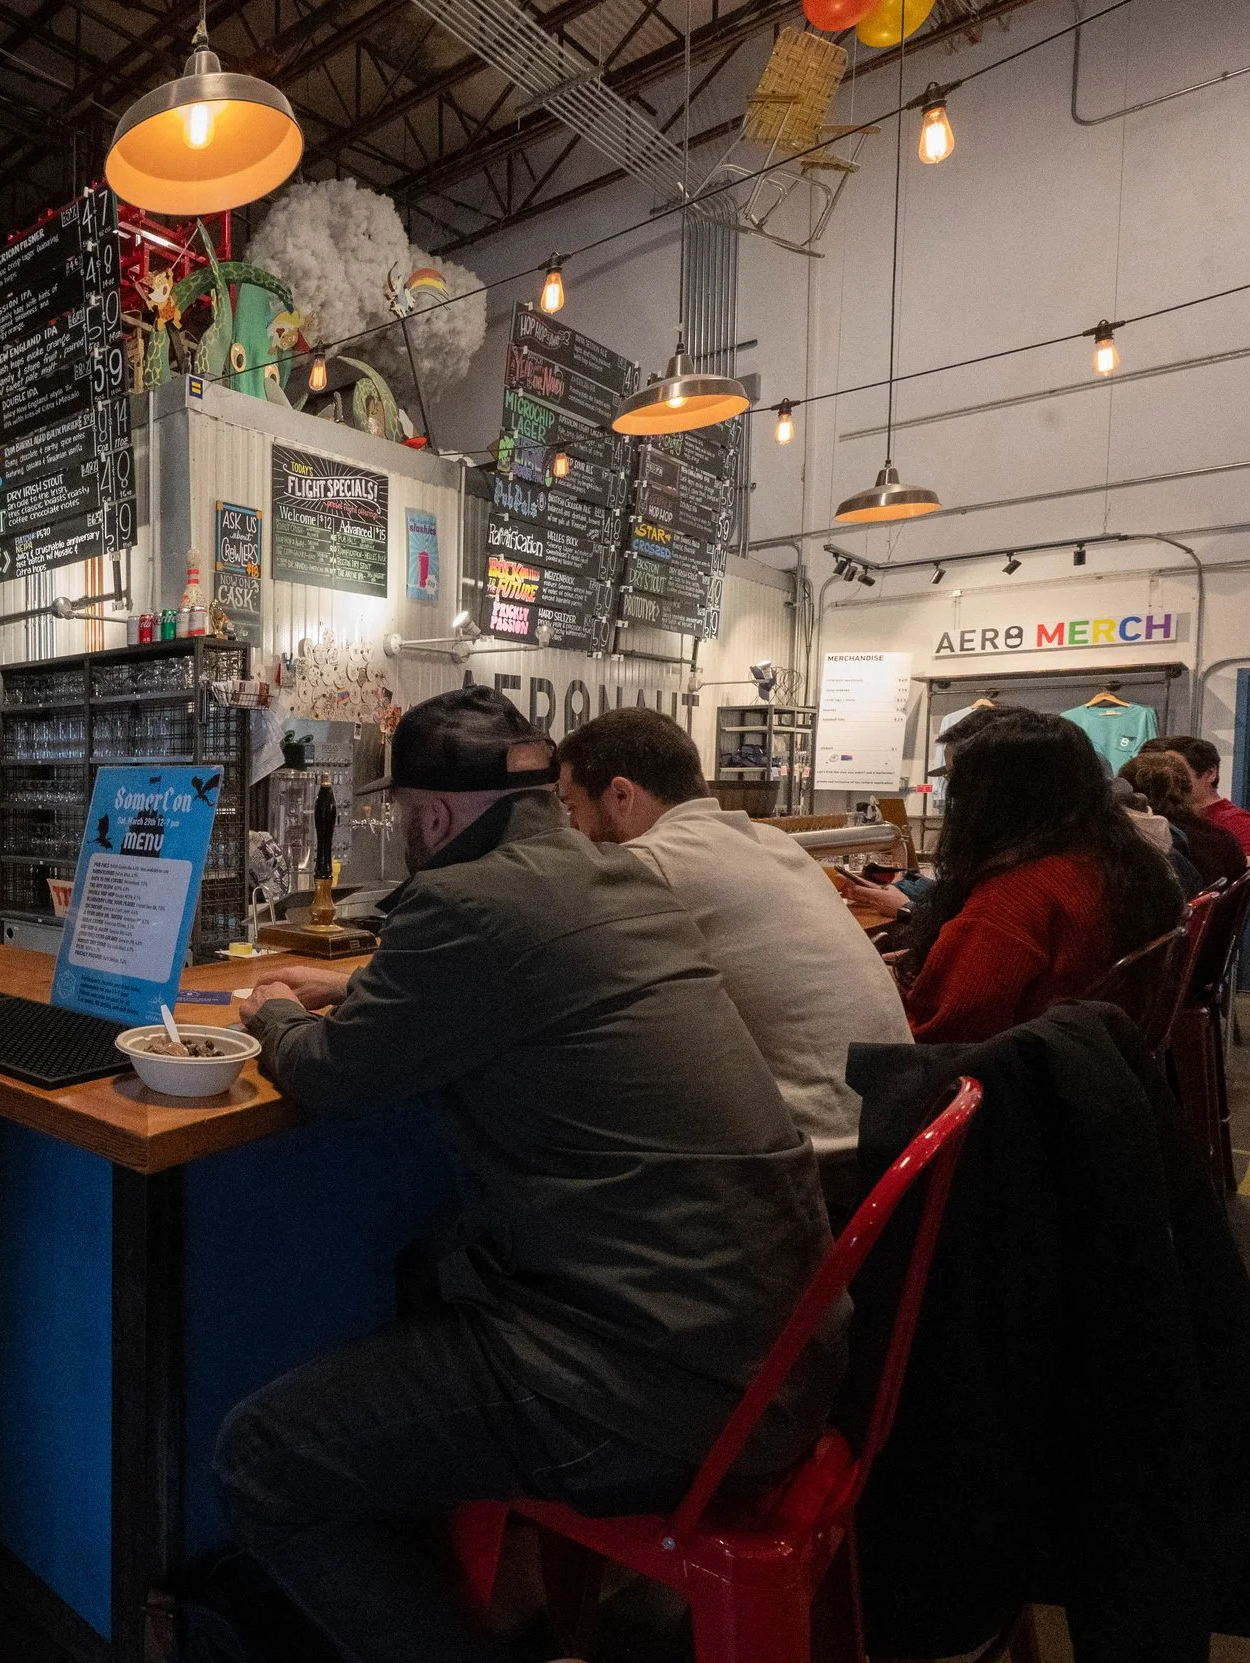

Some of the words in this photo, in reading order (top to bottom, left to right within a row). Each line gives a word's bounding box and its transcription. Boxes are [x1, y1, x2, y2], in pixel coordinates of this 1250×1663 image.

[20, 229, 45, 251] PILSNER
[20, 289, 32, 302] IPA
[51, 283, 59, 294] of
[105, 290, 119, 331] 9
[520, 314, 536, 337] HOP
[535, 321, 548, 343] HOP
[10, 333, 41, 358] ENGLAND
[44, 325, 58, 341] IPA
[10, 356, 25, 371] hops
[27, 346, 44, 362] evoke
[47, 332, 70, 353] orange
[24, 358, 41, 374] stone
[63, 336, 85, 359] paired
[94, 353, 105, 393] 5
[110, 348, 122, 386] 9
[5, 376, 24, 394] sweet
[25, 371, 38, 387] pale
[2, 391, 27, 411] DOUBLE
[27, 386, 39, 401] IPA
[28, 394, 49, 411] England
[505, 389, 556, 429] MICROCHIP
[114, 397, 127, 435] 14
[511, 412, 547, 444] LAGER
[101, 456, 112, 494] 4
[117, 450, 130, 489] 8
[291, 461, 314, 478] TODAY'S
[584, 463, 594, 475] ALE
[7, 488, 22, 503] DRY
[23, 480, 41, 500] IRISH
[42, 474, 64, 492] STOUT
[287, 475, 326, 499] FLIGHT
[326, 479, 378, 502] SPECIALS!
[494, 477, 514, 509] Pub
[513, 483, 538, 518] Pals
[7, 502, 17, 511] an
[30, 495, 37, 504] to
[38, 491, 50, 502] the
[8, 508, 20, 520] this
[21, 500, 44, 515] classic
[45, 493, 67, 508] boasts
[67, 486, 90, 500] roasty
[8, 515, 29, 528] coffee
[30, 506, 60, 520] chocolate
[61, 498, 80, 511] notes
[119, 503, 132, 540] 9
[222, 511, 242, 530] ASK
[246, 515, 258, 534] US
[279, 505, 316, 527] Welcome
[648, 505, 660, 518] HOP
[659, 507, 673, 523] HOP
[230, 530, 254, 541] about
[339, 519, 373, 539] Advanced
[409, 523, 437, 536] slushies
[489, 523, 544, 558] Ramification
[548, 530, 566, 542] HELLES
[566, 535, 579, 547] BOCK
[614, 518, 622, 540] 8
[636, 523, 666, 545] STAR
[15, 549, 30, 562] Juicy
[35, 540, 65, 556] crushable
[66, 530, 100, 548] anniversary
[16, 559, 27, 569] test
[28, 554, 45, 566] batch
[54, 546, 73, 560] Mosaic
[221, 537, 259, 567] CROWLERS
[16, 567, 32, 579] Citra
[32, 563, 47, 574] hops
[246, 561, 260, 578] $18
[544, 569, 576, 586] WEIZENBOCK
[637, 558, 660, 574] BOSTON
[220, 575, 238, 587] NOW
[238, 577, 251, 589] ON
[496, 578, 539, 603] FUTURE
[630, 567, 645, 588] DRY
[644, 572, 666, 594] STOUT
[493, 601, 530, 622] PRICKLY
[538, 607, 553, 620] HARD
[553, 611, 577, 624] SELTZER
[490, 615, 529, 635] PASSION
[600, 621, 610, 647] 9
[935, 625, 1024, 654] AERO
[1036, 613, 1172, 648] MERCH
[114, 786, 193, 814] SomerCon
[129, 816, 143, 826] March
[123, 832, 165, 852] MENU
